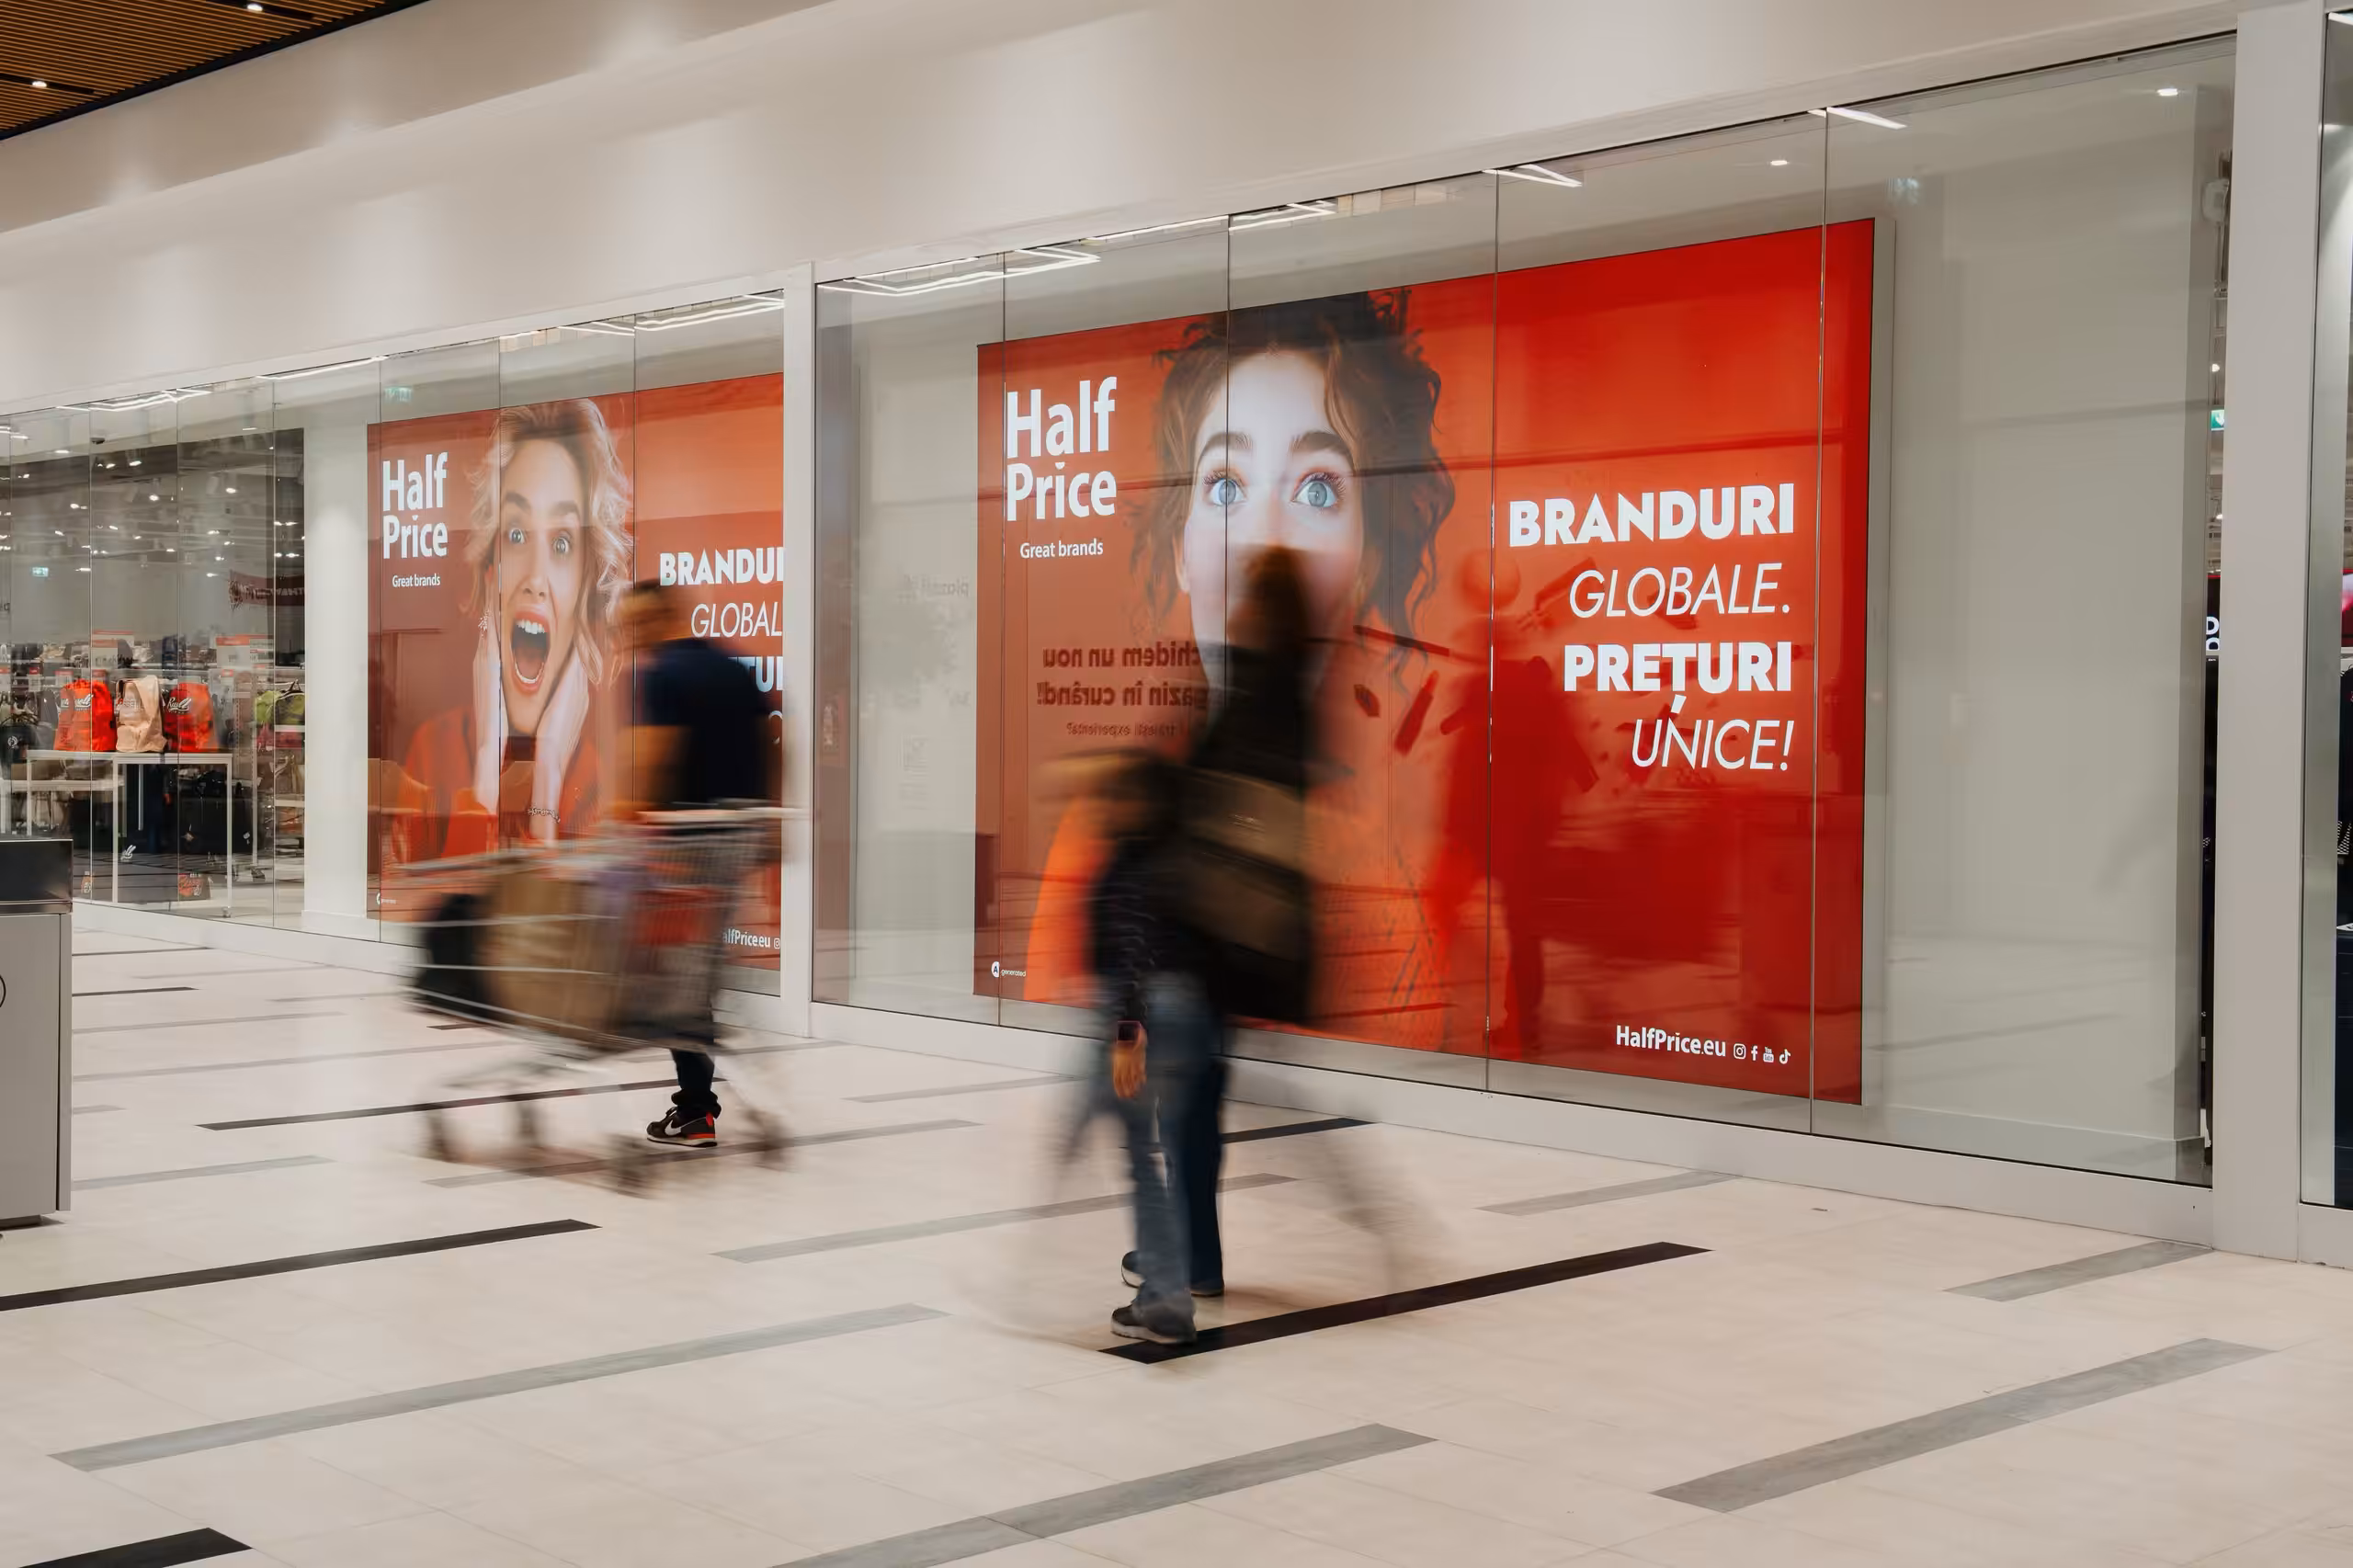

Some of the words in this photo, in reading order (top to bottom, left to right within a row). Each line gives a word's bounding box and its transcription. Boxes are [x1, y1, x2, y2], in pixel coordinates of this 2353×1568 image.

[1007, 377, 1117, 459] Half
[382, 452, 449, 511] Half
[1007, 462, 1117, 521] Price
[382, 515, 449, 559] Price
[1509, 483, 1794, 547] BRANDURI
[660, 547, 783, 586] BRANDU
[1020, 541, 1055, 559] Great
[1058, 538, 1103, 557] brands
[392, 574, 414, 587] Great
[415, 574, 440, 586] brands
[1569, 562, 1790, 618] GLOBALE.
[691, 601, 783, 638] GLOBAL
[1631, 719, 1794, 771] UNICE!
[1616, 1025, 1726, 1057] HalfPrice.eu
